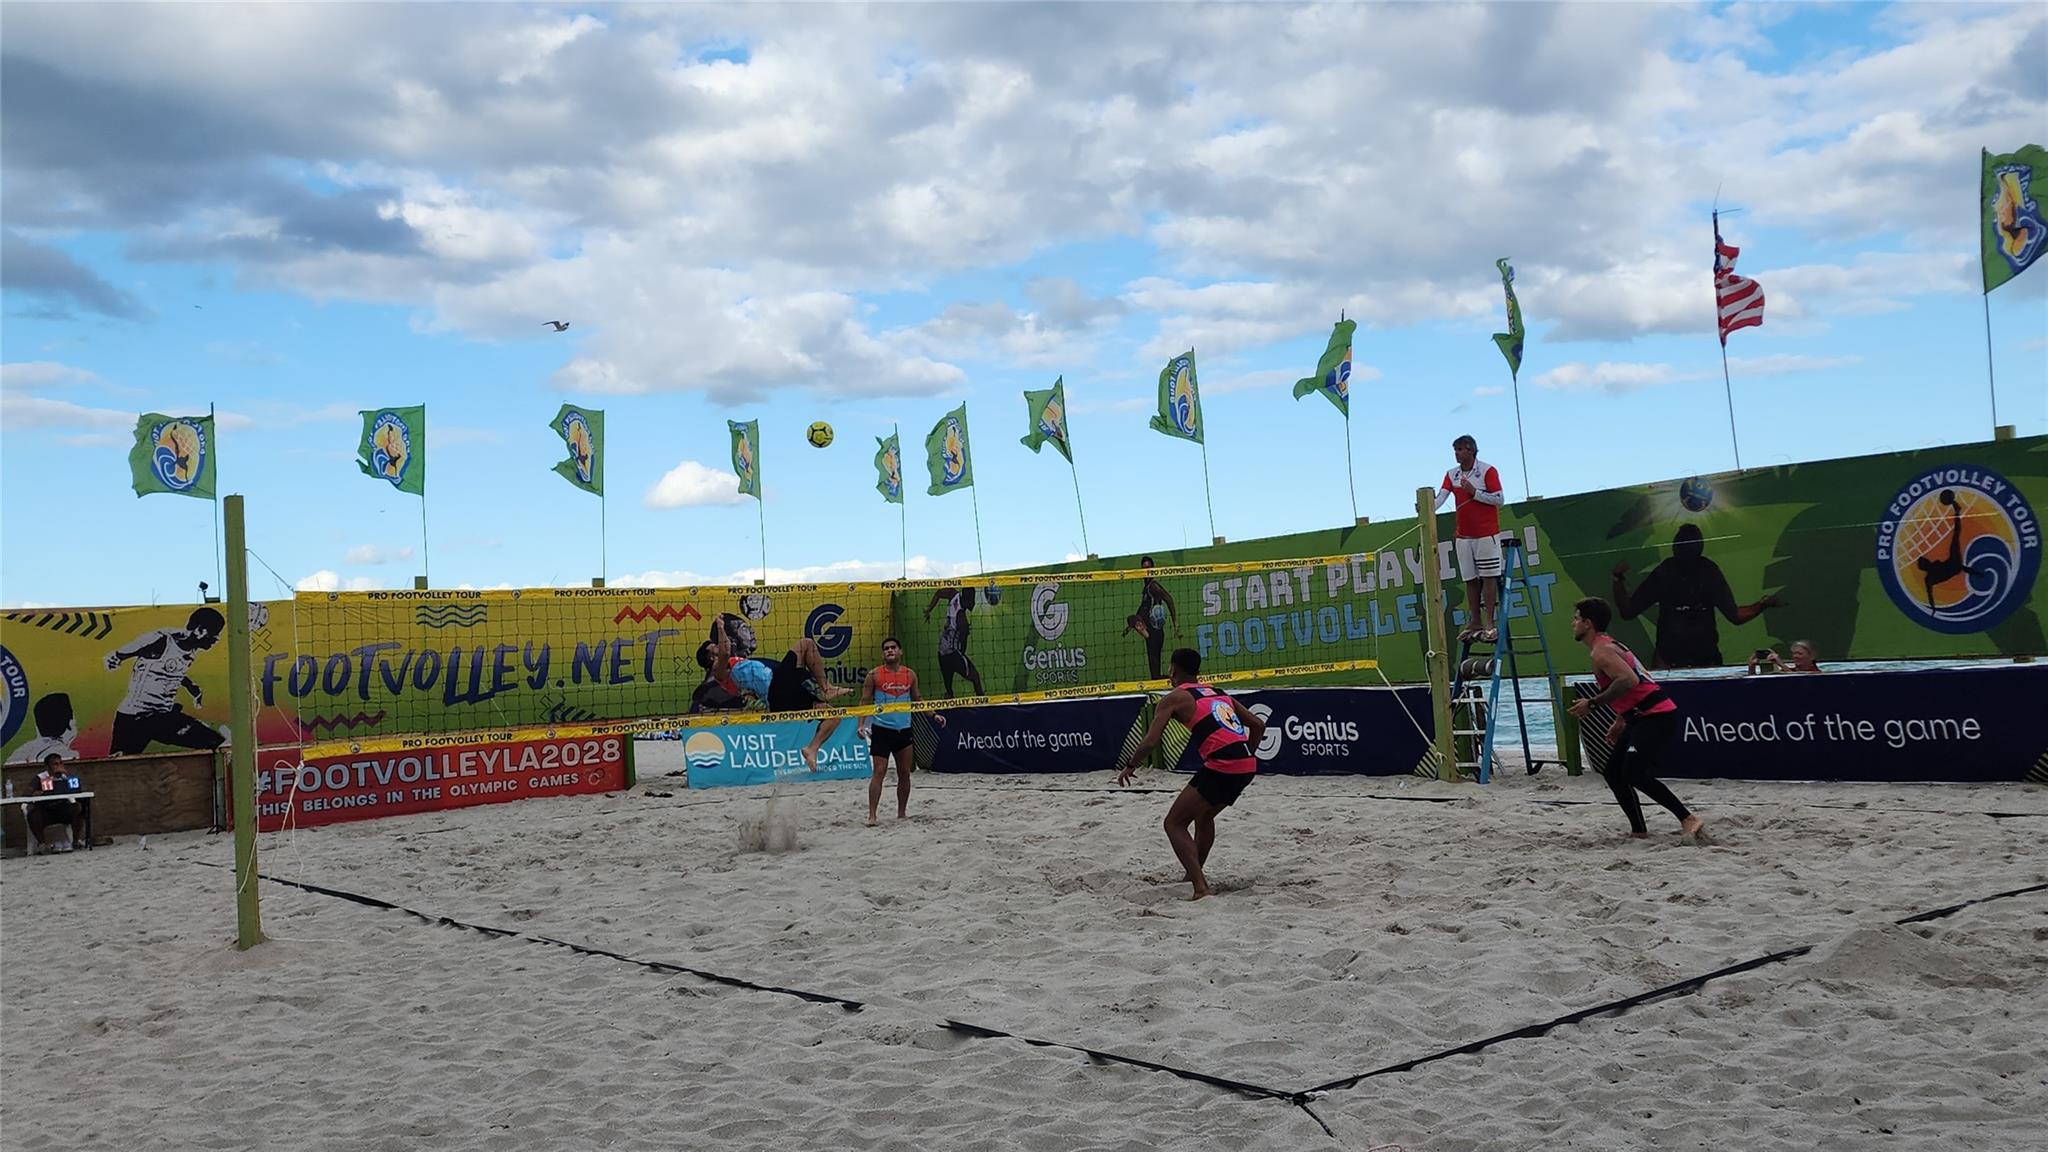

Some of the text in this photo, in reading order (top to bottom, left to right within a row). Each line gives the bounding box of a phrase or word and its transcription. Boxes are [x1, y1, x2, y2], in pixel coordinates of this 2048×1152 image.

[1878, 469, 2039, 560] PRO FOOTVOLLEY TOUR
[1147, 569, 1159, 577] PRO
[1160, 567, 1197, 575] FOOTVOLLEY
[1203, 526, 1541, 617] START PLAYI!
[728, 587, 743, 595] PRO
[746, 586, 794, 594] FOOTVOLLEY
[897, 580, 942, 588] FOOTVOLLEY
[943, 579, 962, 587] TOUR
[368, 591, 481, 600] PRO FOOTVOLLEY TOUR
[575, 589, 631, 597] FOOTVOLLEY
[633, 588, 656, 596] TOUR
[1195, 573, 1558, 658] FOOTVOLLE.ET
[1023, 642, 1086, 670] Genius
[0, 655, 26, 698] TOUR
[262, 629, 680, 708] FOOTVOLLEY.NET
[823, 661, 869, 687] nius
[1036, 670, 1079, 685] SPORTS
[1044, 684, 1116, 698] PRO FOOTVOLLEY TOUR
[910, 697, 989, 710] PRO FOOTVOLLEY TOUR
[760, 708, 848, 722] PRO FOOTVOLLEY TOUR
[592, 719, 691, 734] PRO FOOTVOLLEY TOUR
[1285, 714, 1359, 743] Genius
[1683, 713, 1982, 747] Ahead of the game
[402, 733, 513, 748] PRO FOOTVOLLEY TOUR
[728, 734, 777, 751] VISIT
[957, 729, 1093, 752] Ahead of the game
[1301, 743, 1350, 756] SPORTS
[254, 738, 622, 797] #FOOTVOLLEYLA2028
[68, 778, 79, 789] 13
[303, 793, 377, 812] BELONGS
[387, 790, 404, 804] IN
[412, 787, 441, 801] THE
[449, 780, 518, 798] OLYMPIC
[529, 773, 580, 789] GAMES
